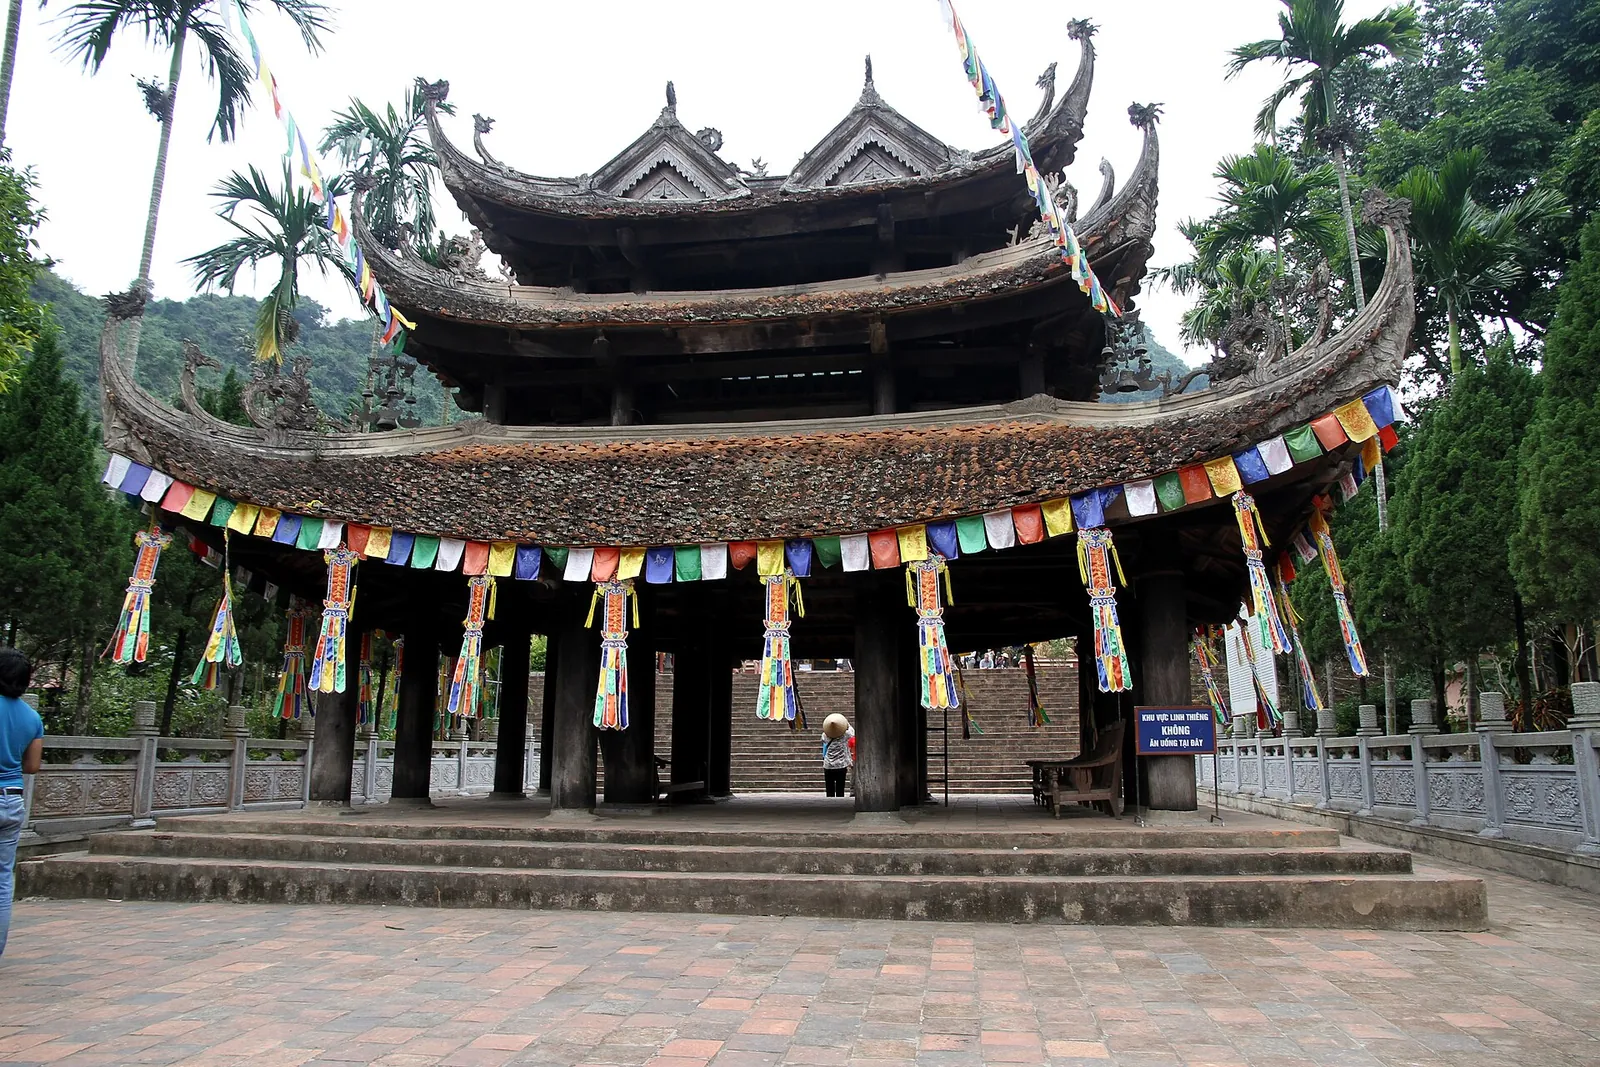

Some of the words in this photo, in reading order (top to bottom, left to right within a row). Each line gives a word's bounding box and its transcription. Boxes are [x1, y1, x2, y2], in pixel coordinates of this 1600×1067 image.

[1141, 713, 1155, 722] KHU
[1156, 713, 1169, 723] VỰC
[1170, 713, 1185, 722] LINH
[1185, 712, 1209, 721] THIÊNG
[1161, 724, 1190, 735] KHÔNG
[1160, 737, 1178, 747] UỐNG
[1179, 739, 1189, 748] TẠI
[1190, 738, 1203, 747] ĐÂY
